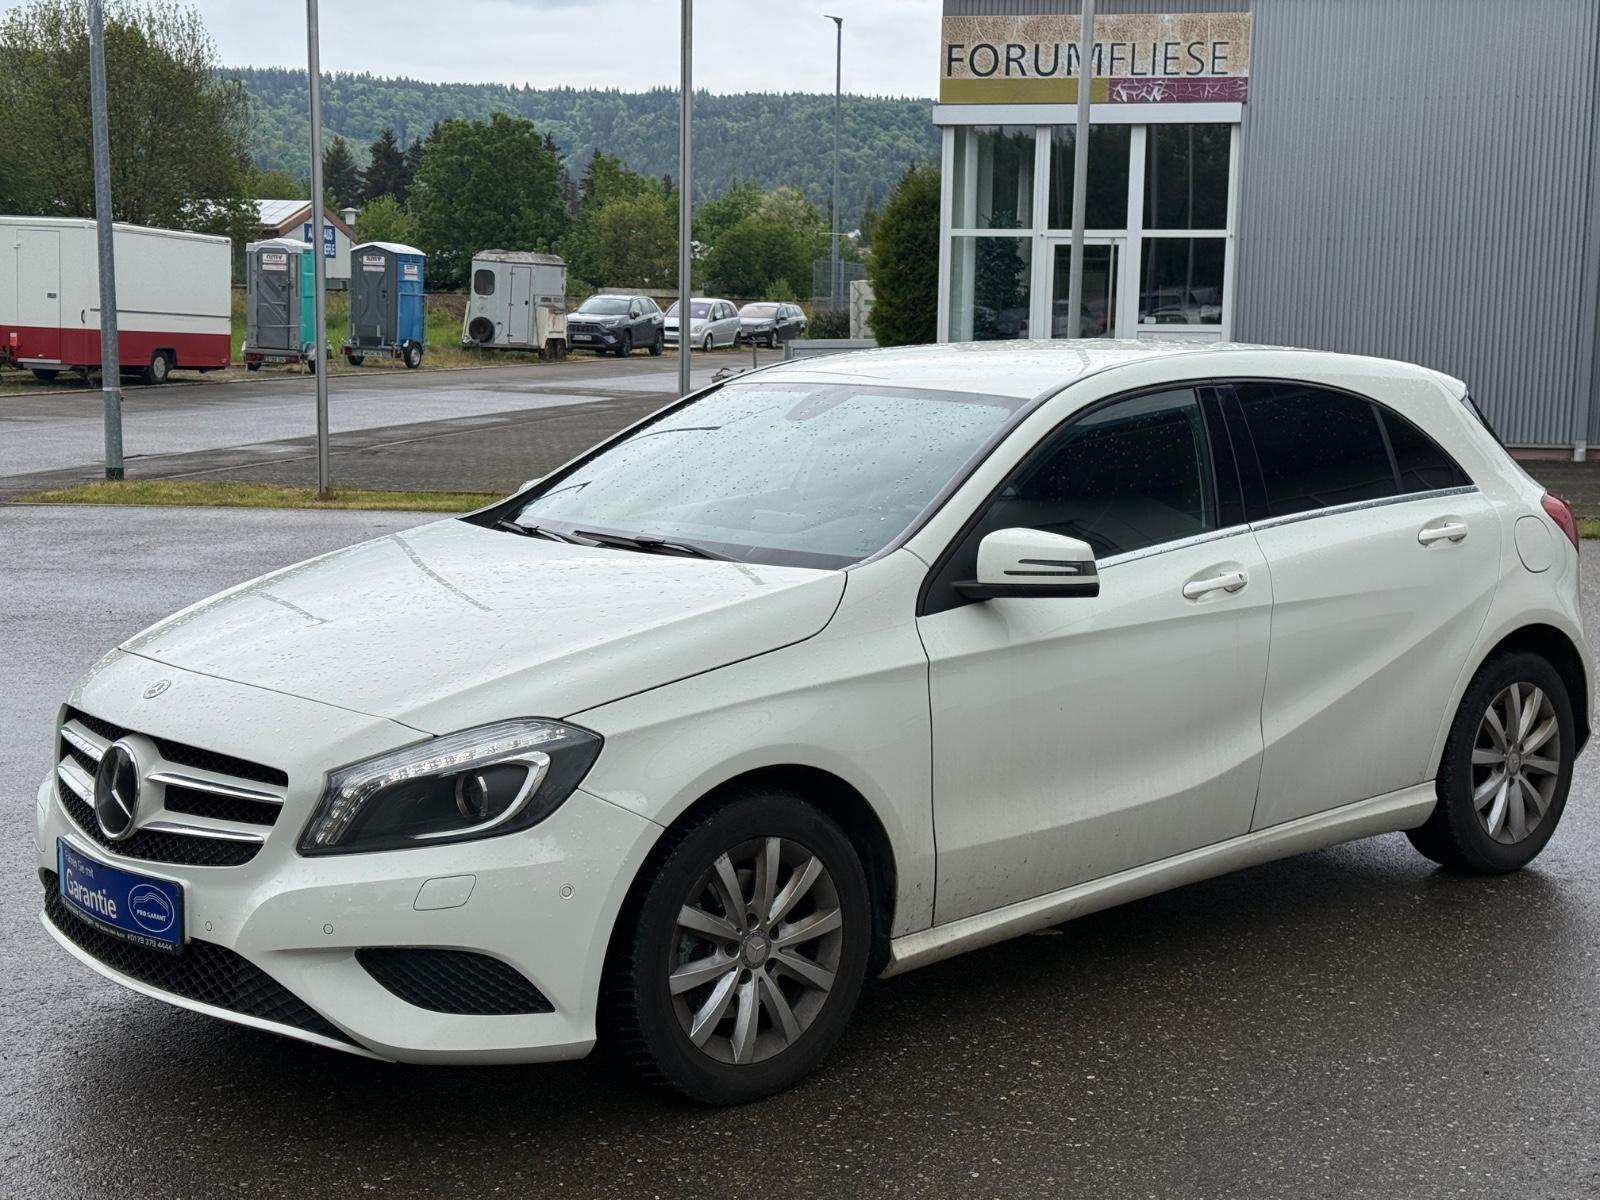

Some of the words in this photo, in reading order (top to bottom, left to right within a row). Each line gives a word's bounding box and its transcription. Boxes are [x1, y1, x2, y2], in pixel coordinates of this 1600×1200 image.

[66, 868, 117, 919] Garantie
[136, 909, 146, 917] PRO
[147, 911, 167, 922] GARANT
